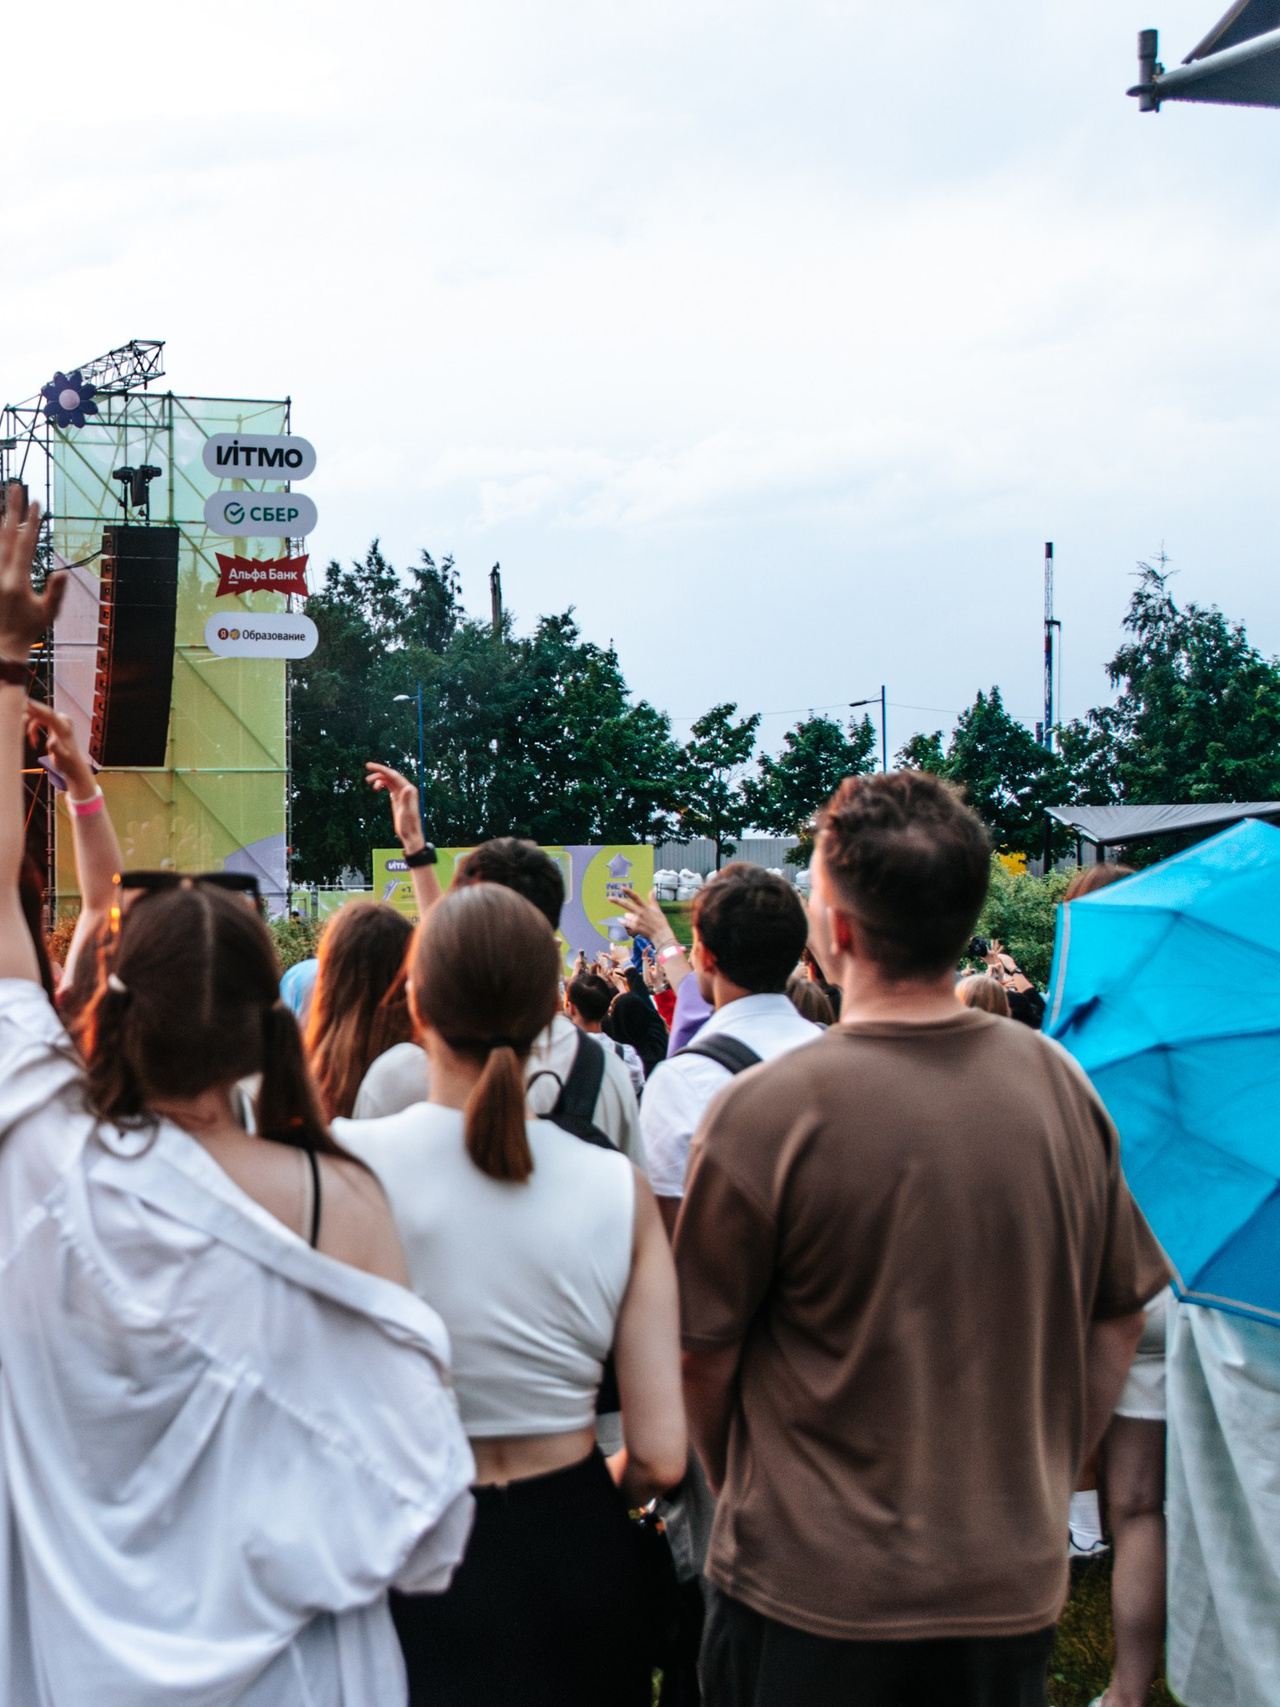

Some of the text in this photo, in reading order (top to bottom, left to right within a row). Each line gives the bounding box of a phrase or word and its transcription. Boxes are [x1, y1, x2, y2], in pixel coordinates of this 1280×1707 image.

[250, 506, 299, 522] СБЕР
[228, 568, 298, 584] Альфа Банк
[242, 629, 306, 642] Образование
